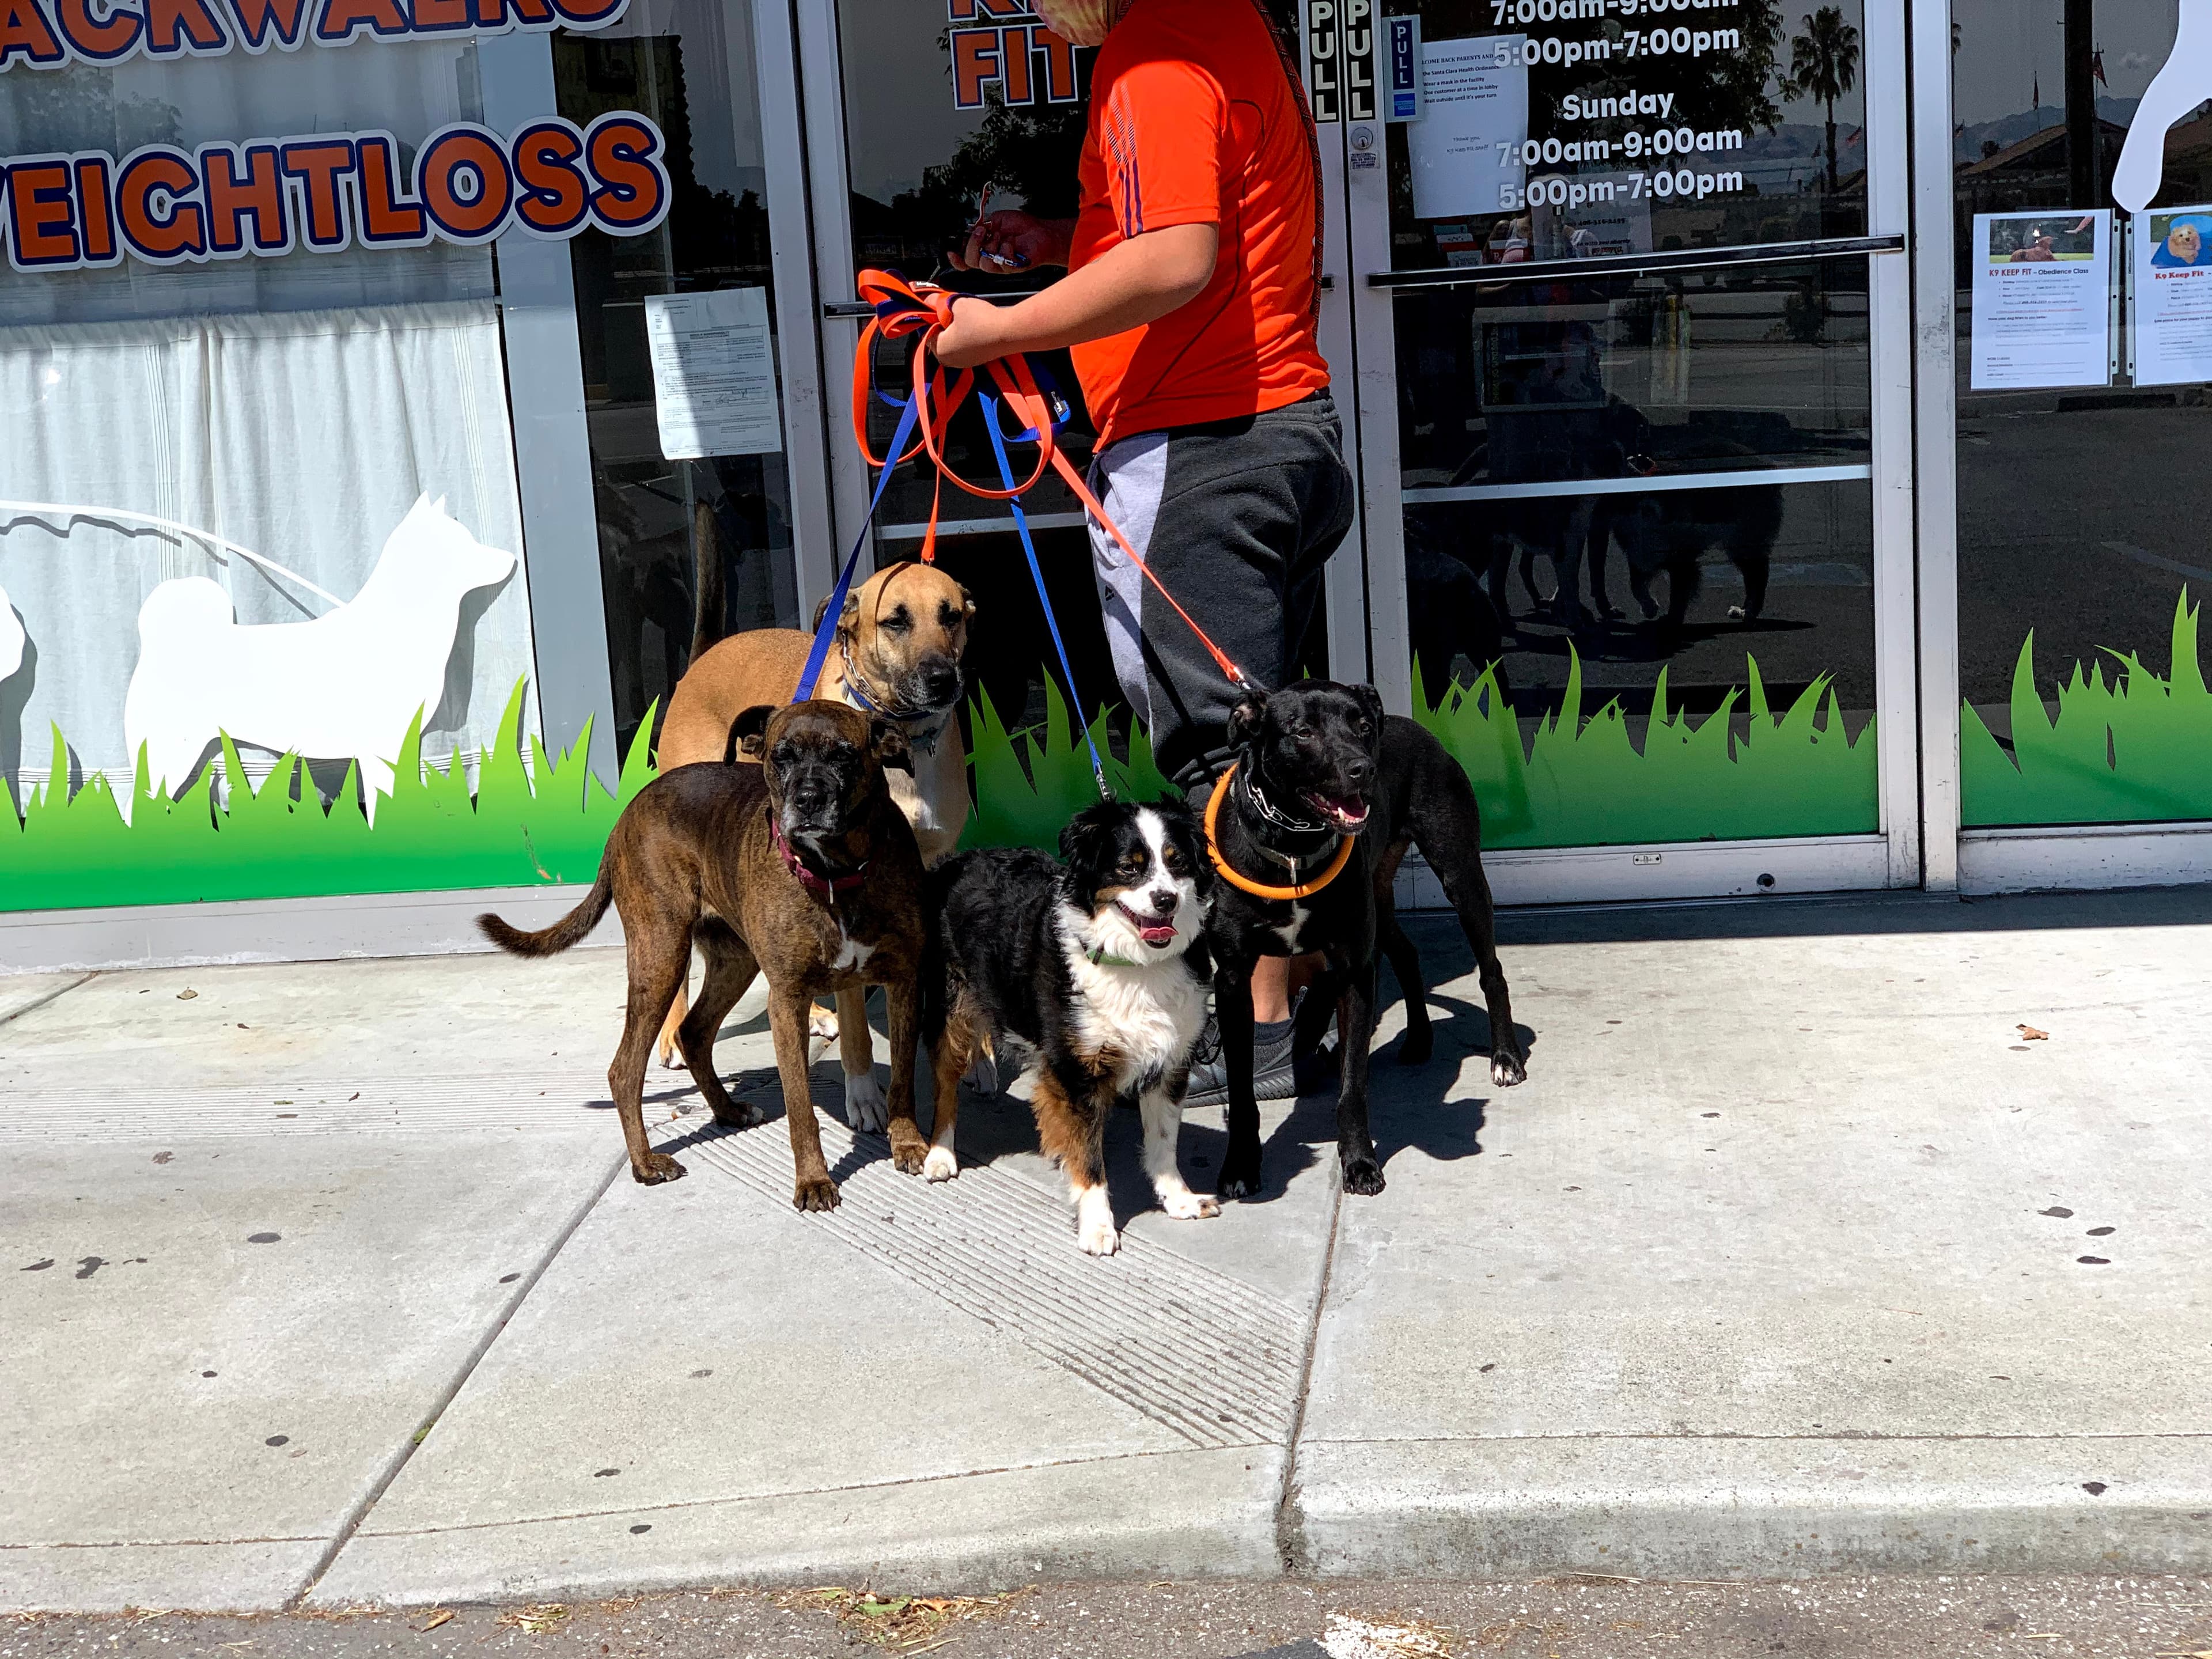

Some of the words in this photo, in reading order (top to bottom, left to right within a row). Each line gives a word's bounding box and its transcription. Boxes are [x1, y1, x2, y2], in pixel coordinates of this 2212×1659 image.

[950, 24, 1088, 110] FIT
[1312, 1, 1336, 121] PULL
[1347, 0, 1373, 118] PULL
[1397, 26, 1408, 84] PULL
[1494, 26, 1739, 67] 5:00pm-7:00pm
[1562, 89, 1674, 120] Sunday
[1496, 127, 1743, 168] 7:00am-9:00am
[0, 114, 669, 268] EIGHTLOSS
[1499, 169, 1743, 209] 5:00pm-7:00pm
